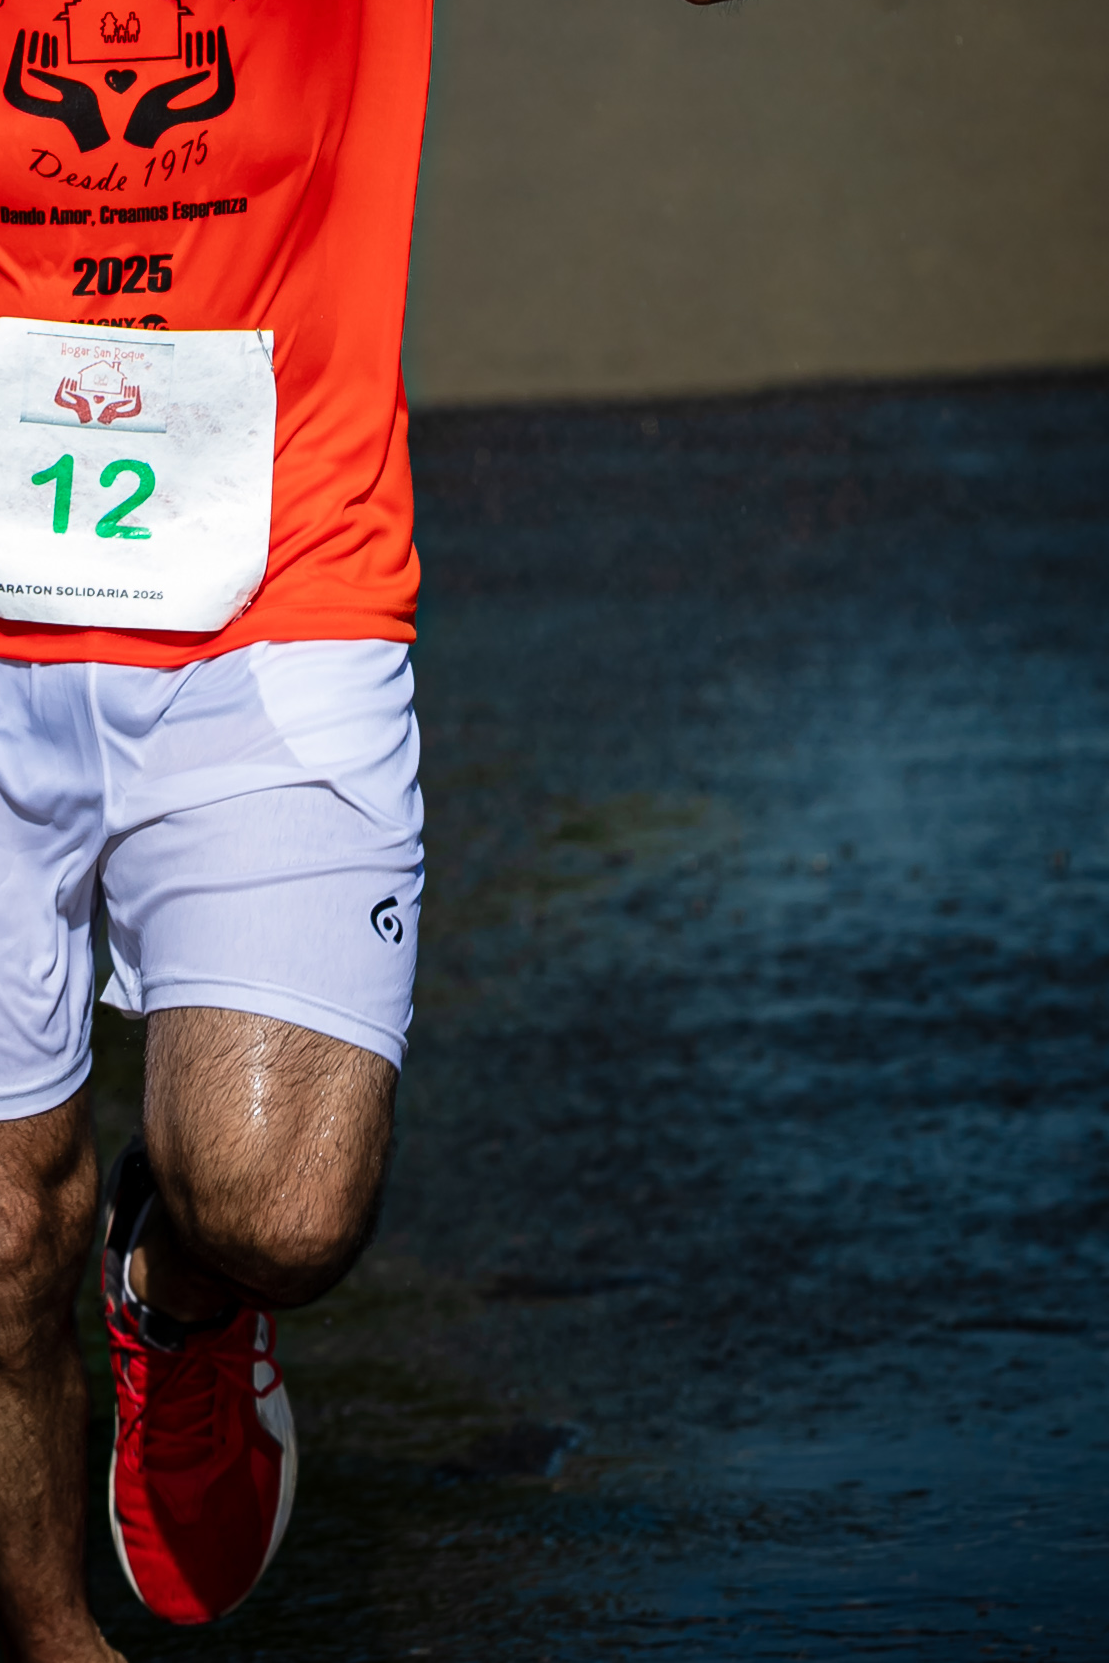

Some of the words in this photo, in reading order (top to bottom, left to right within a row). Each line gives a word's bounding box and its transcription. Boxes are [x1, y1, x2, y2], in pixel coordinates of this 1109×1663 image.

[28, 148, 127, 192] Desde
[144, 130, 209, 187] 1975
[0, 206, 45, 225] Dando
[50, 206, 96, 227] Amor,
[100, 206, 169, 224] Creamos
[172, 197, 247, 221] Esperanza
[73, 254, 174, 295] 2025
[60, 342, 91, 357] Hogar
[93, 346, 112, 359] San
[113, 347, 145, 361] Roque
[31, 454, 156, 540] 12
[56, 586, 129, 599] SOLIDARIA
[132, 589, 164, 600] 2025
